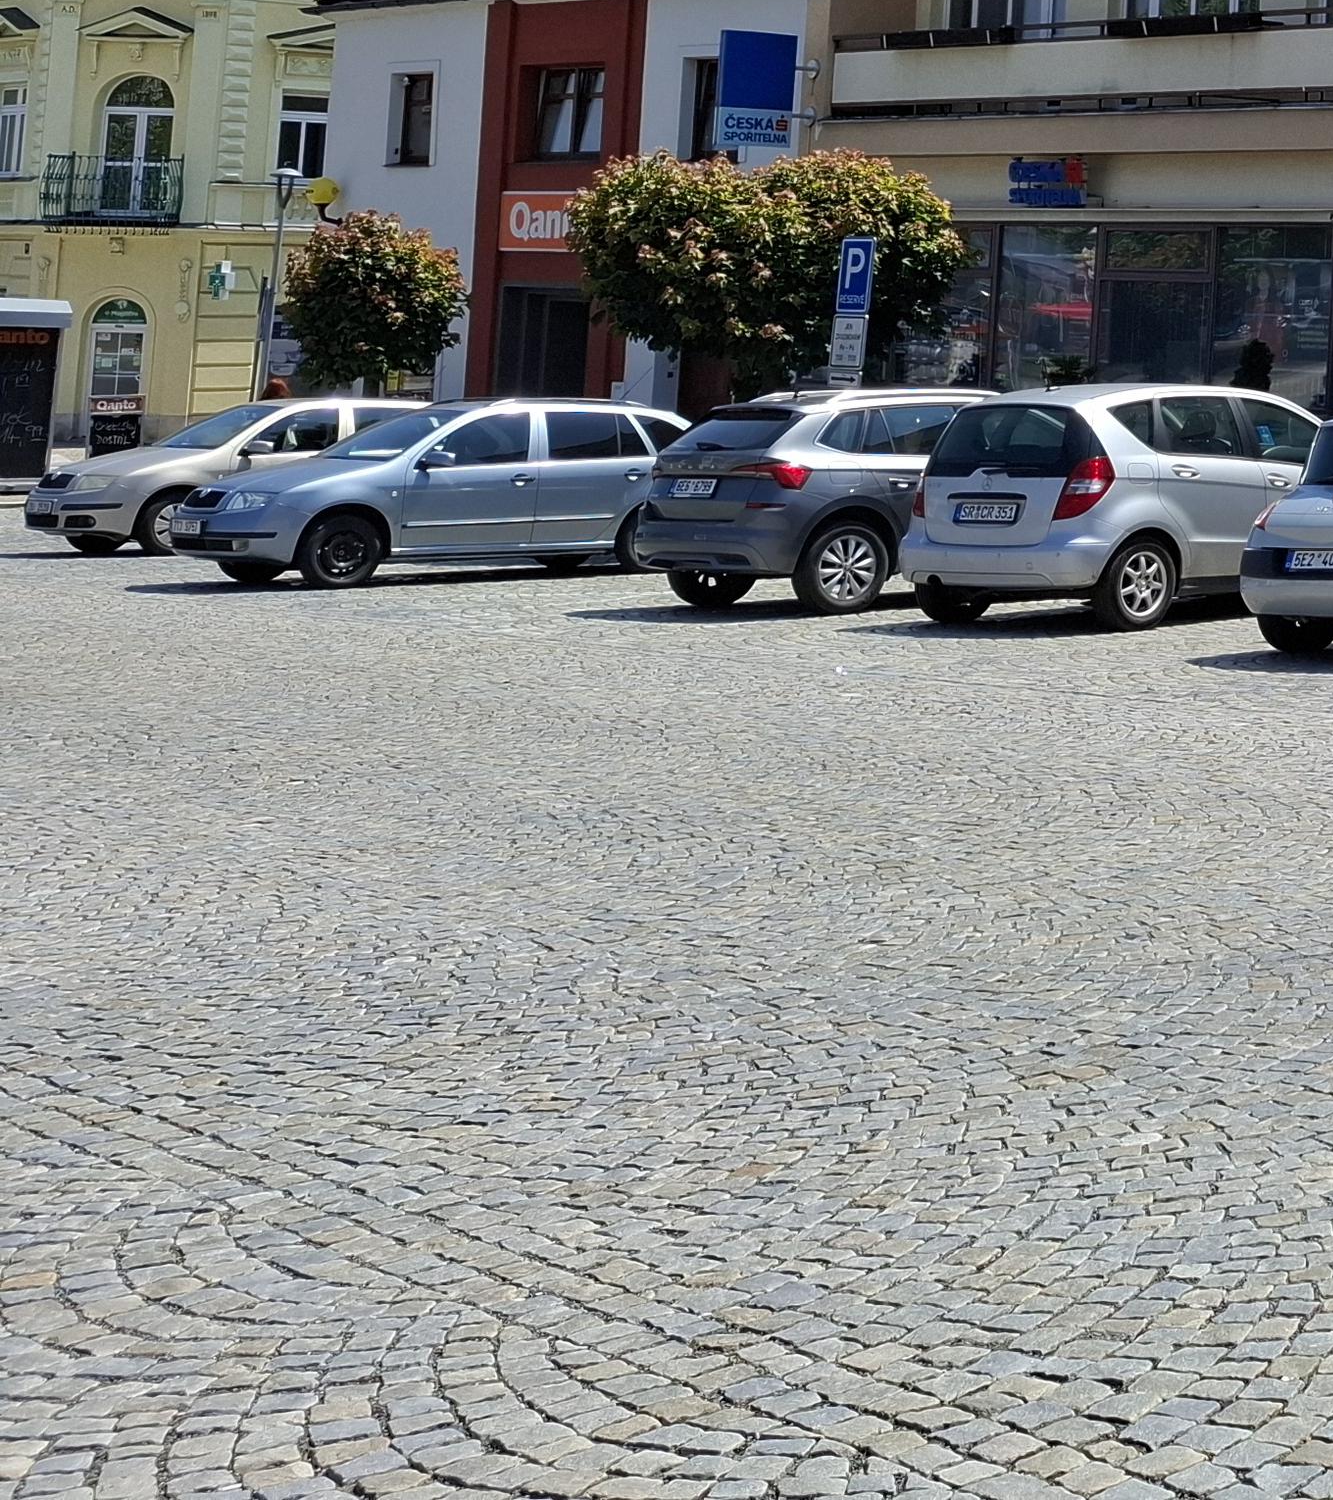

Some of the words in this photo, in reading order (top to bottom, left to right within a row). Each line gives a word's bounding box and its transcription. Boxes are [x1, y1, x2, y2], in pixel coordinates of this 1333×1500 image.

[724, 112, 774, 132] ČESKÁ
[723, 129, 787, 145] SPOŘITELNA
[0, 329, 49, 345] anto
[97, 400, 136, 411] Qanto
[961, 505, 975, 519] SR
[981, 505, 994, 519] CR
[995, 505, 1014, 519] 351
[1294, 553, 1315, 567] 5E2
